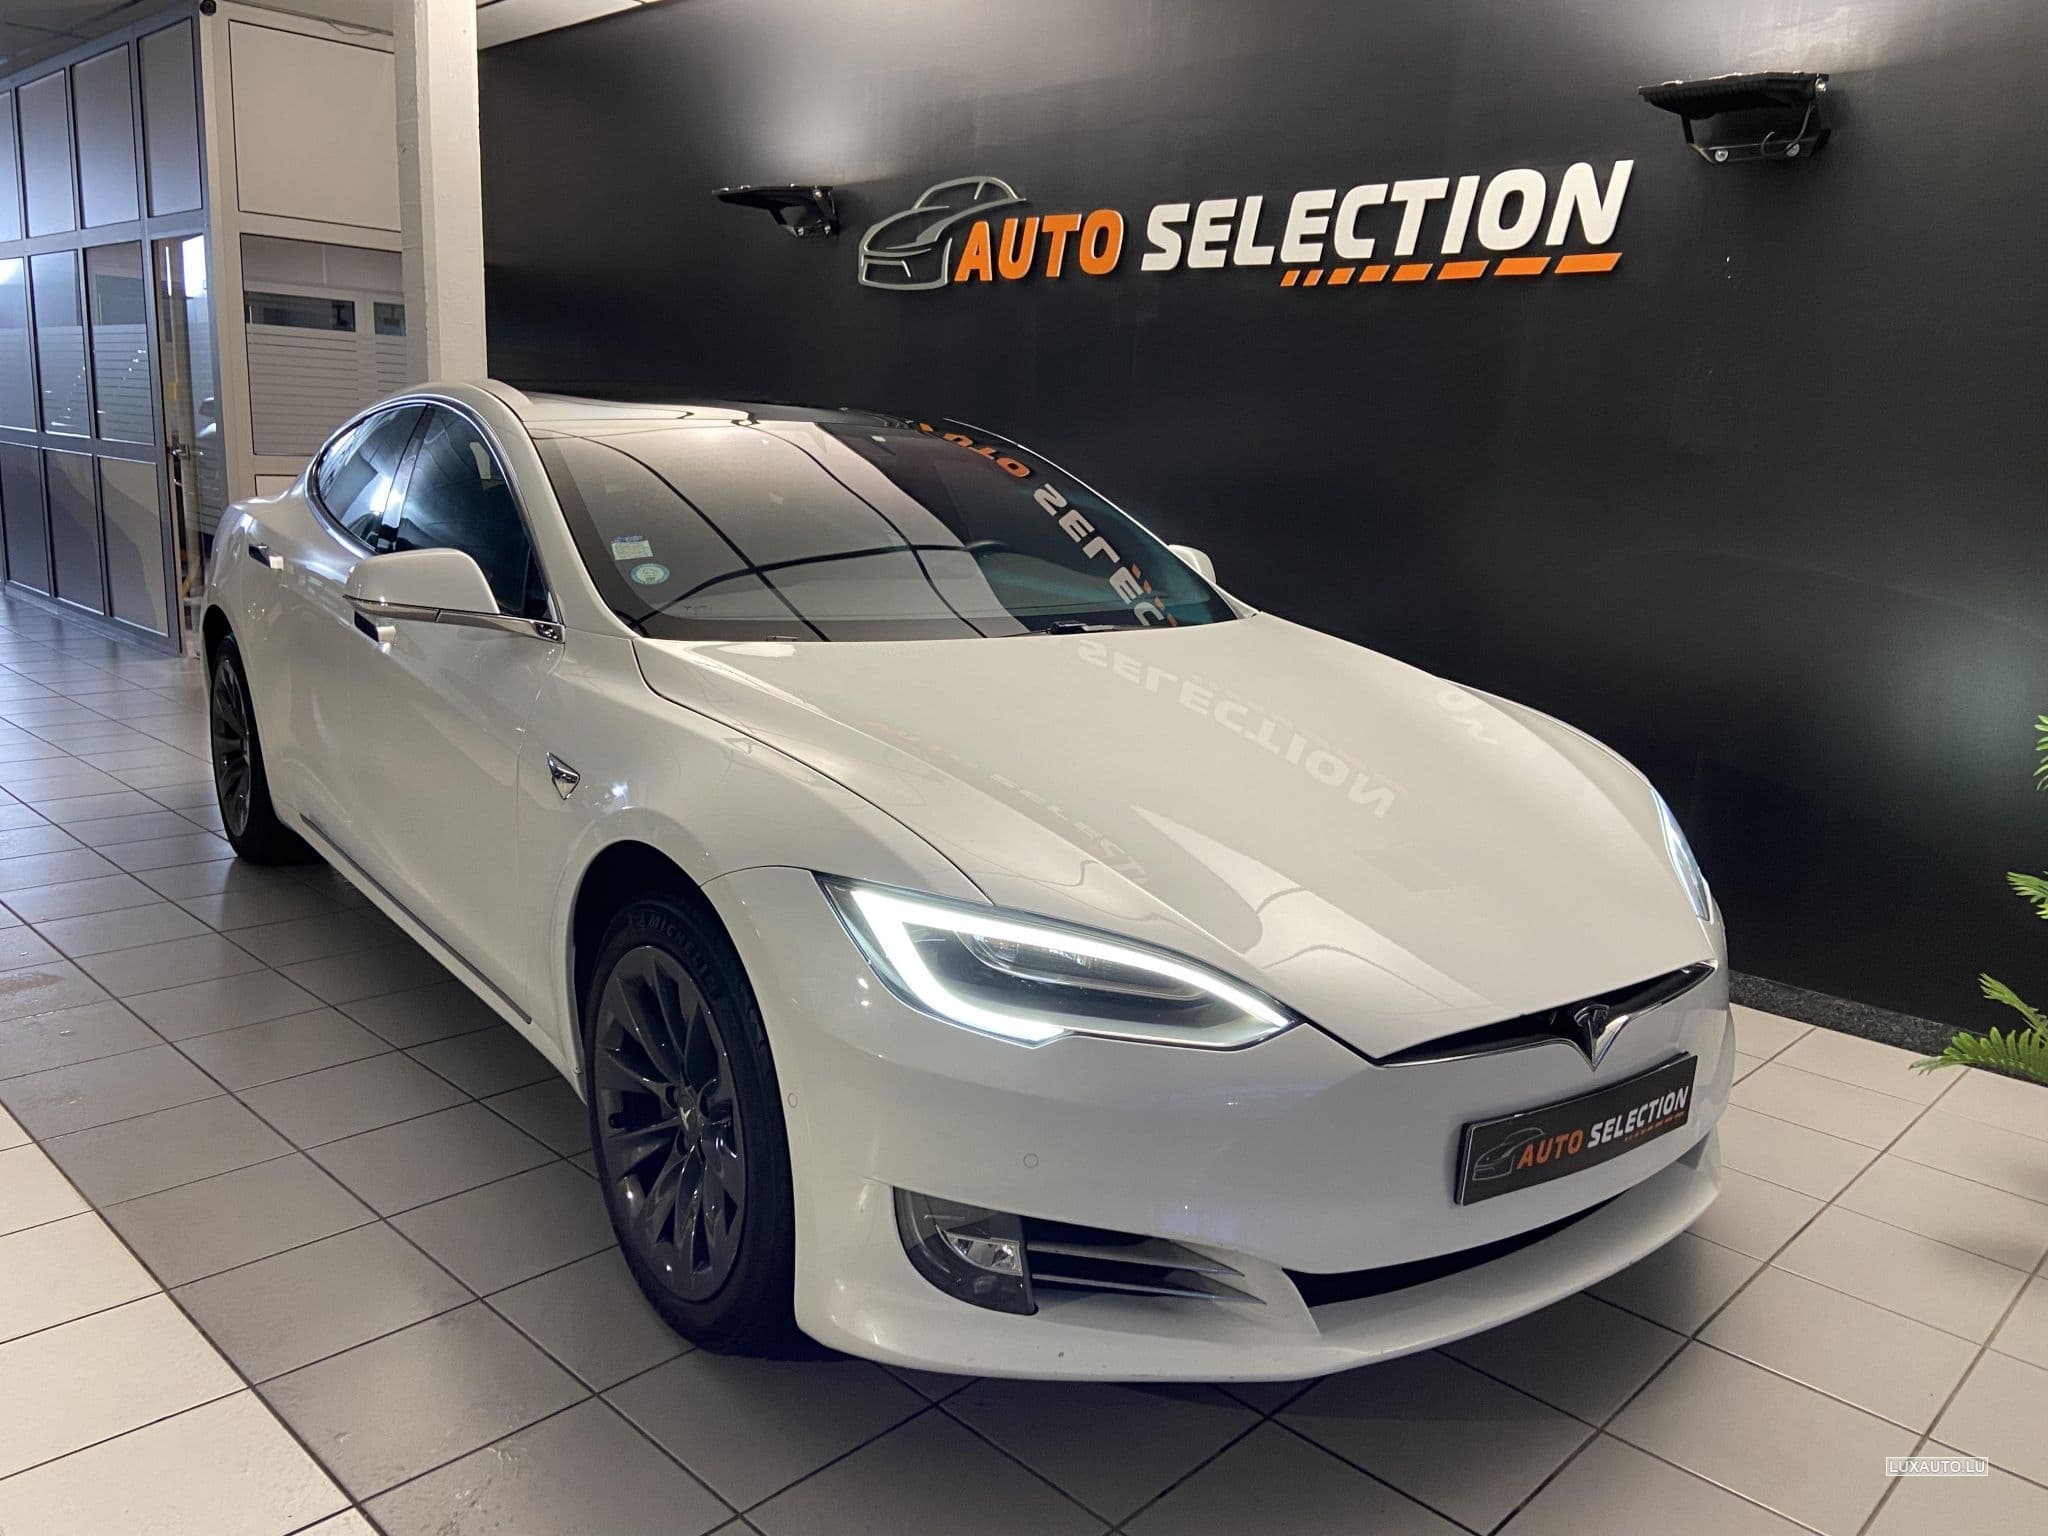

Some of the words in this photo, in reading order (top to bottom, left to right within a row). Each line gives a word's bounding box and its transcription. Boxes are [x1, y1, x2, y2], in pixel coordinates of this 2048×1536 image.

[954, 208, 1125, 283] AUTO
[1140, 159, 1635, 272] SELECTION
[1517, 1129, 1584, 1170] AUTO
[1587, 1085, 1689, 1148] SELECTION
